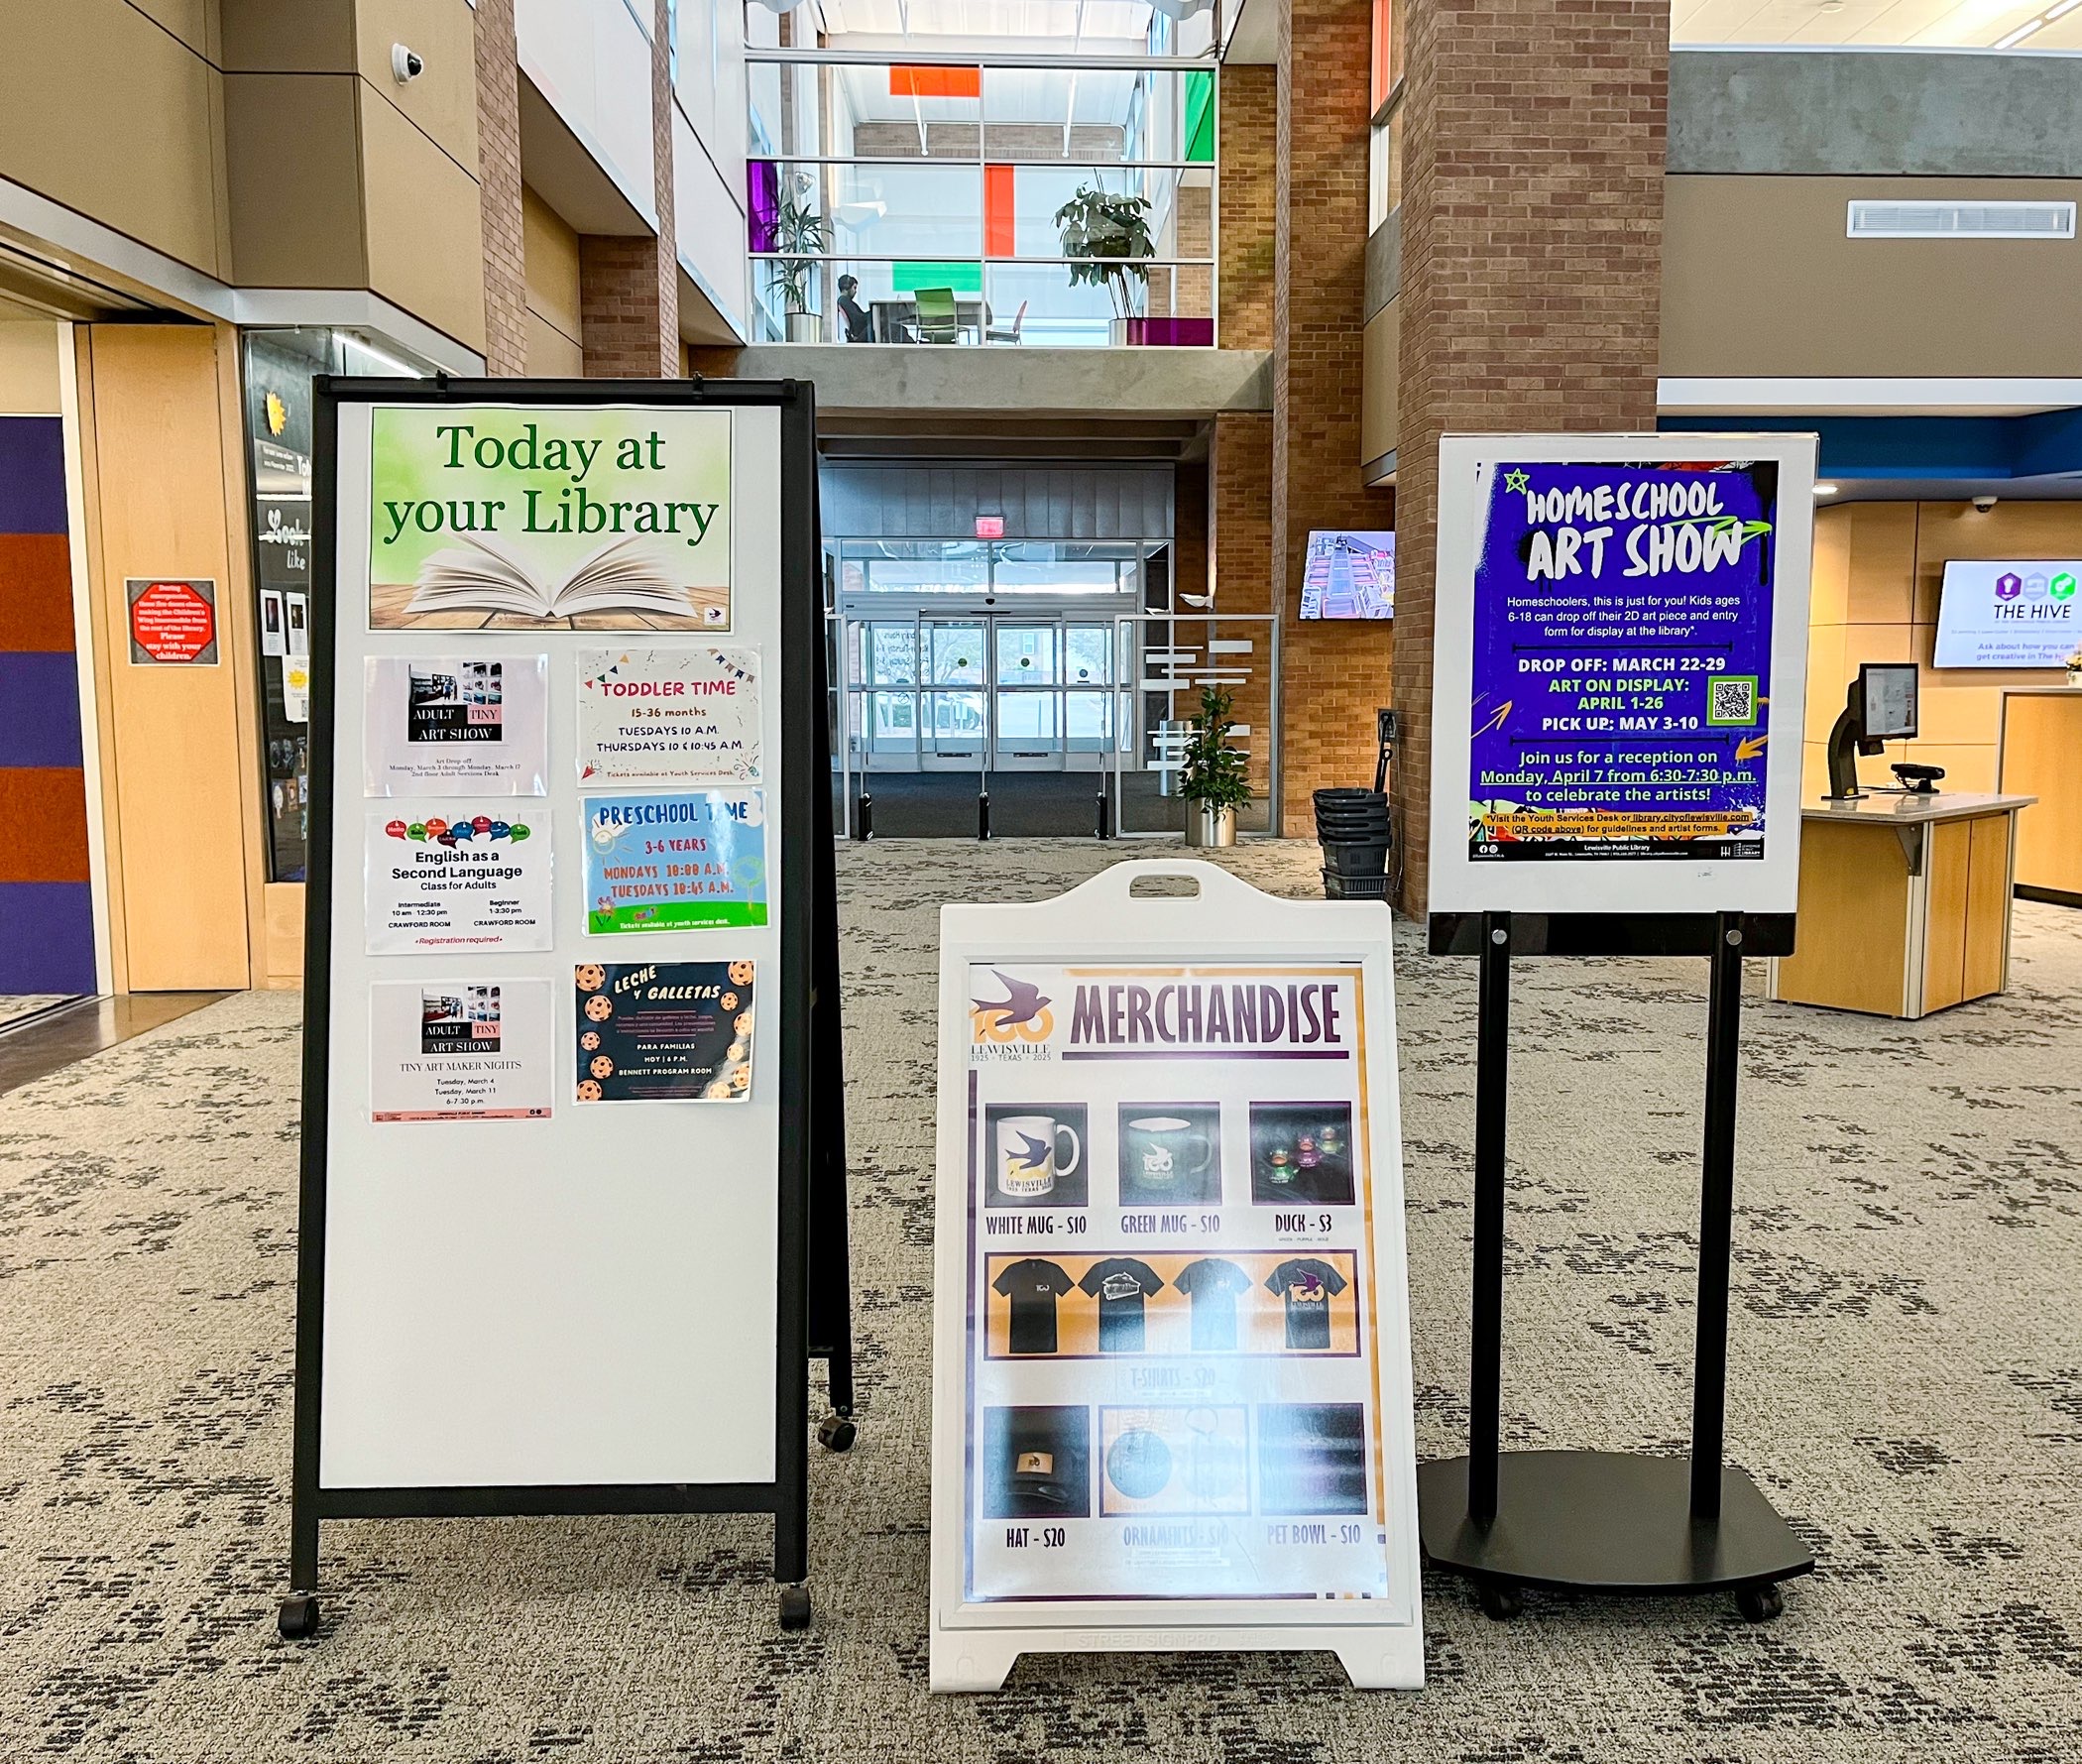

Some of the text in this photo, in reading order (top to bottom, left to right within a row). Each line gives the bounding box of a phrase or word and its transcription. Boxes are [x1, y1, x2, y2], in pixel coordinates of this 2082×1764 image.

[436, 424, 666, 483] Today at
[1526, 480, 1724, 526] HOMESCHOOL
[383, 488, 720, 546] your Library
[1527, 521, 1744, 581] ART SHOW
[287, 549, 306, 570] like
[1507, 595, 1740, 608] Homeschoolers, this is just for you! Kids ages
[1508, 610, 1738, 624] 6-18 can drop off their 2D art piece and entry
[1994, 604, 2071, 619] THE HIVE
[1544, 625, 1655, 639] form for display at the
[1518, 657, 1726, 672] DROP OFF: MARCH 22-29
[601, 680, 736, 697] TODDLER TIME
[1549, 678, 1689, 693] ART ON DISPLAY:
[1577, 696, 1664, 711] APRIL 1-26
[413, 709, 497, 720] ADULT TINY
[632, 707, 707, 717] 15-36 months
[619, 726, 678, 736] TUESDAYS
[1543, 716, 1698, 731] PICK UP: MAY 3-10
[419, 728, 492, 740] ART SHOW
[597, 742, 717, 753] THURSDAYS 10:45
[1519, 751, 1717, 767] Join us for a reception on
[1480, 769, 1757, 785] Monday, April 7 from 6:30-7:30 p.m.
[1526, 787, 1710, 802] to celebrate the artists!
[600, 803, 698, 825] PRESCHOOL
[1512, 812, 1750, 823] the Youth Services Desk library.cityoflewisville.com
[1531, 824, 1721, 835] code above) for guidelines and artist forms.
[645, 838, 706, 855] 3-6 YEARS
[415, 850, 500, 866] English as a
[392, 867, 522, 881] Second Language
[604, 864, 700, 881] MONDAYS 10:00
[420, 881, 497, 890] Class for Adults
[611, 881, 734, 898] TUESDAYS 10:45 A.M.
[614, 965, 657, 995] LECHE
[647, 986, 721, 1000] GALLETAS
[1070, 984, 1341, 1045] MERCHANDISE
[425, 1025, 498, 1035] ADULT TINY
[430, 1041, 492, 1052] ART SHOW
[972, 1044, 1051, 1054] LEWISVILLE
[400, 1061, 521, 1072] TINY ART MAKER NIGHTS
[985, 1216, 1054, 1235] WHITE MUG
[1120, 1215, 1188, 1234] GREEN MUG
[1275, 1214, 1306, 1233] DUCK
[1130, 1367, 1180, 1387] T-SHIRTS
[1006, 1529, 1029, 1548] HAT
[1123, 1526, 1195, 1546] ORNAMENTS
[1267, 1525, 1328, 1545] PET BOWL
